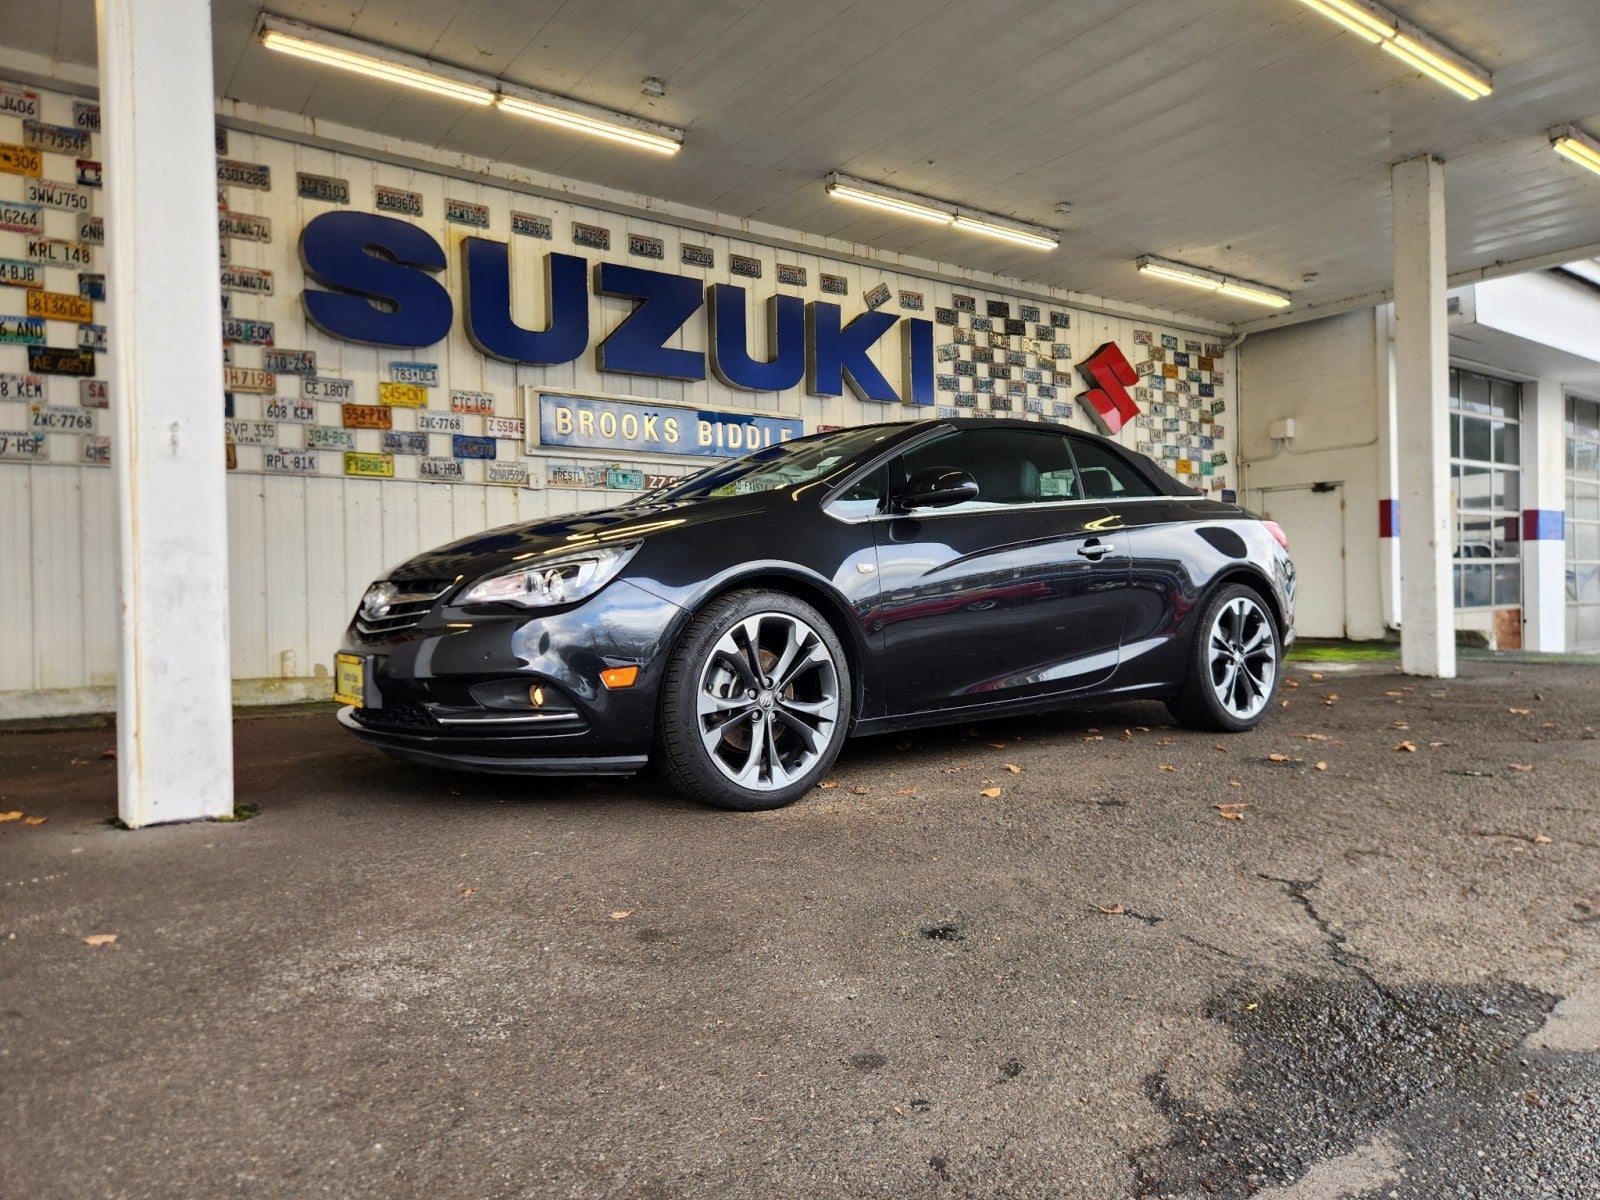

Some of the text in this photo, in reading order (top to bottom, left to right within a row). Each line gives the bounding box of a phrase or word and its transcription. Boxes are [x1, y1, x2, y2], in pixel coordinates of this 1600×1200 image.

[28, 241, 57, 260] KRL
[64, 246, 90, 264] 148
[300, 210, 934, 407] SUZUKI
[323, 383, 350, 398] 1807
[556, 406, 680, 444] BROOKS
